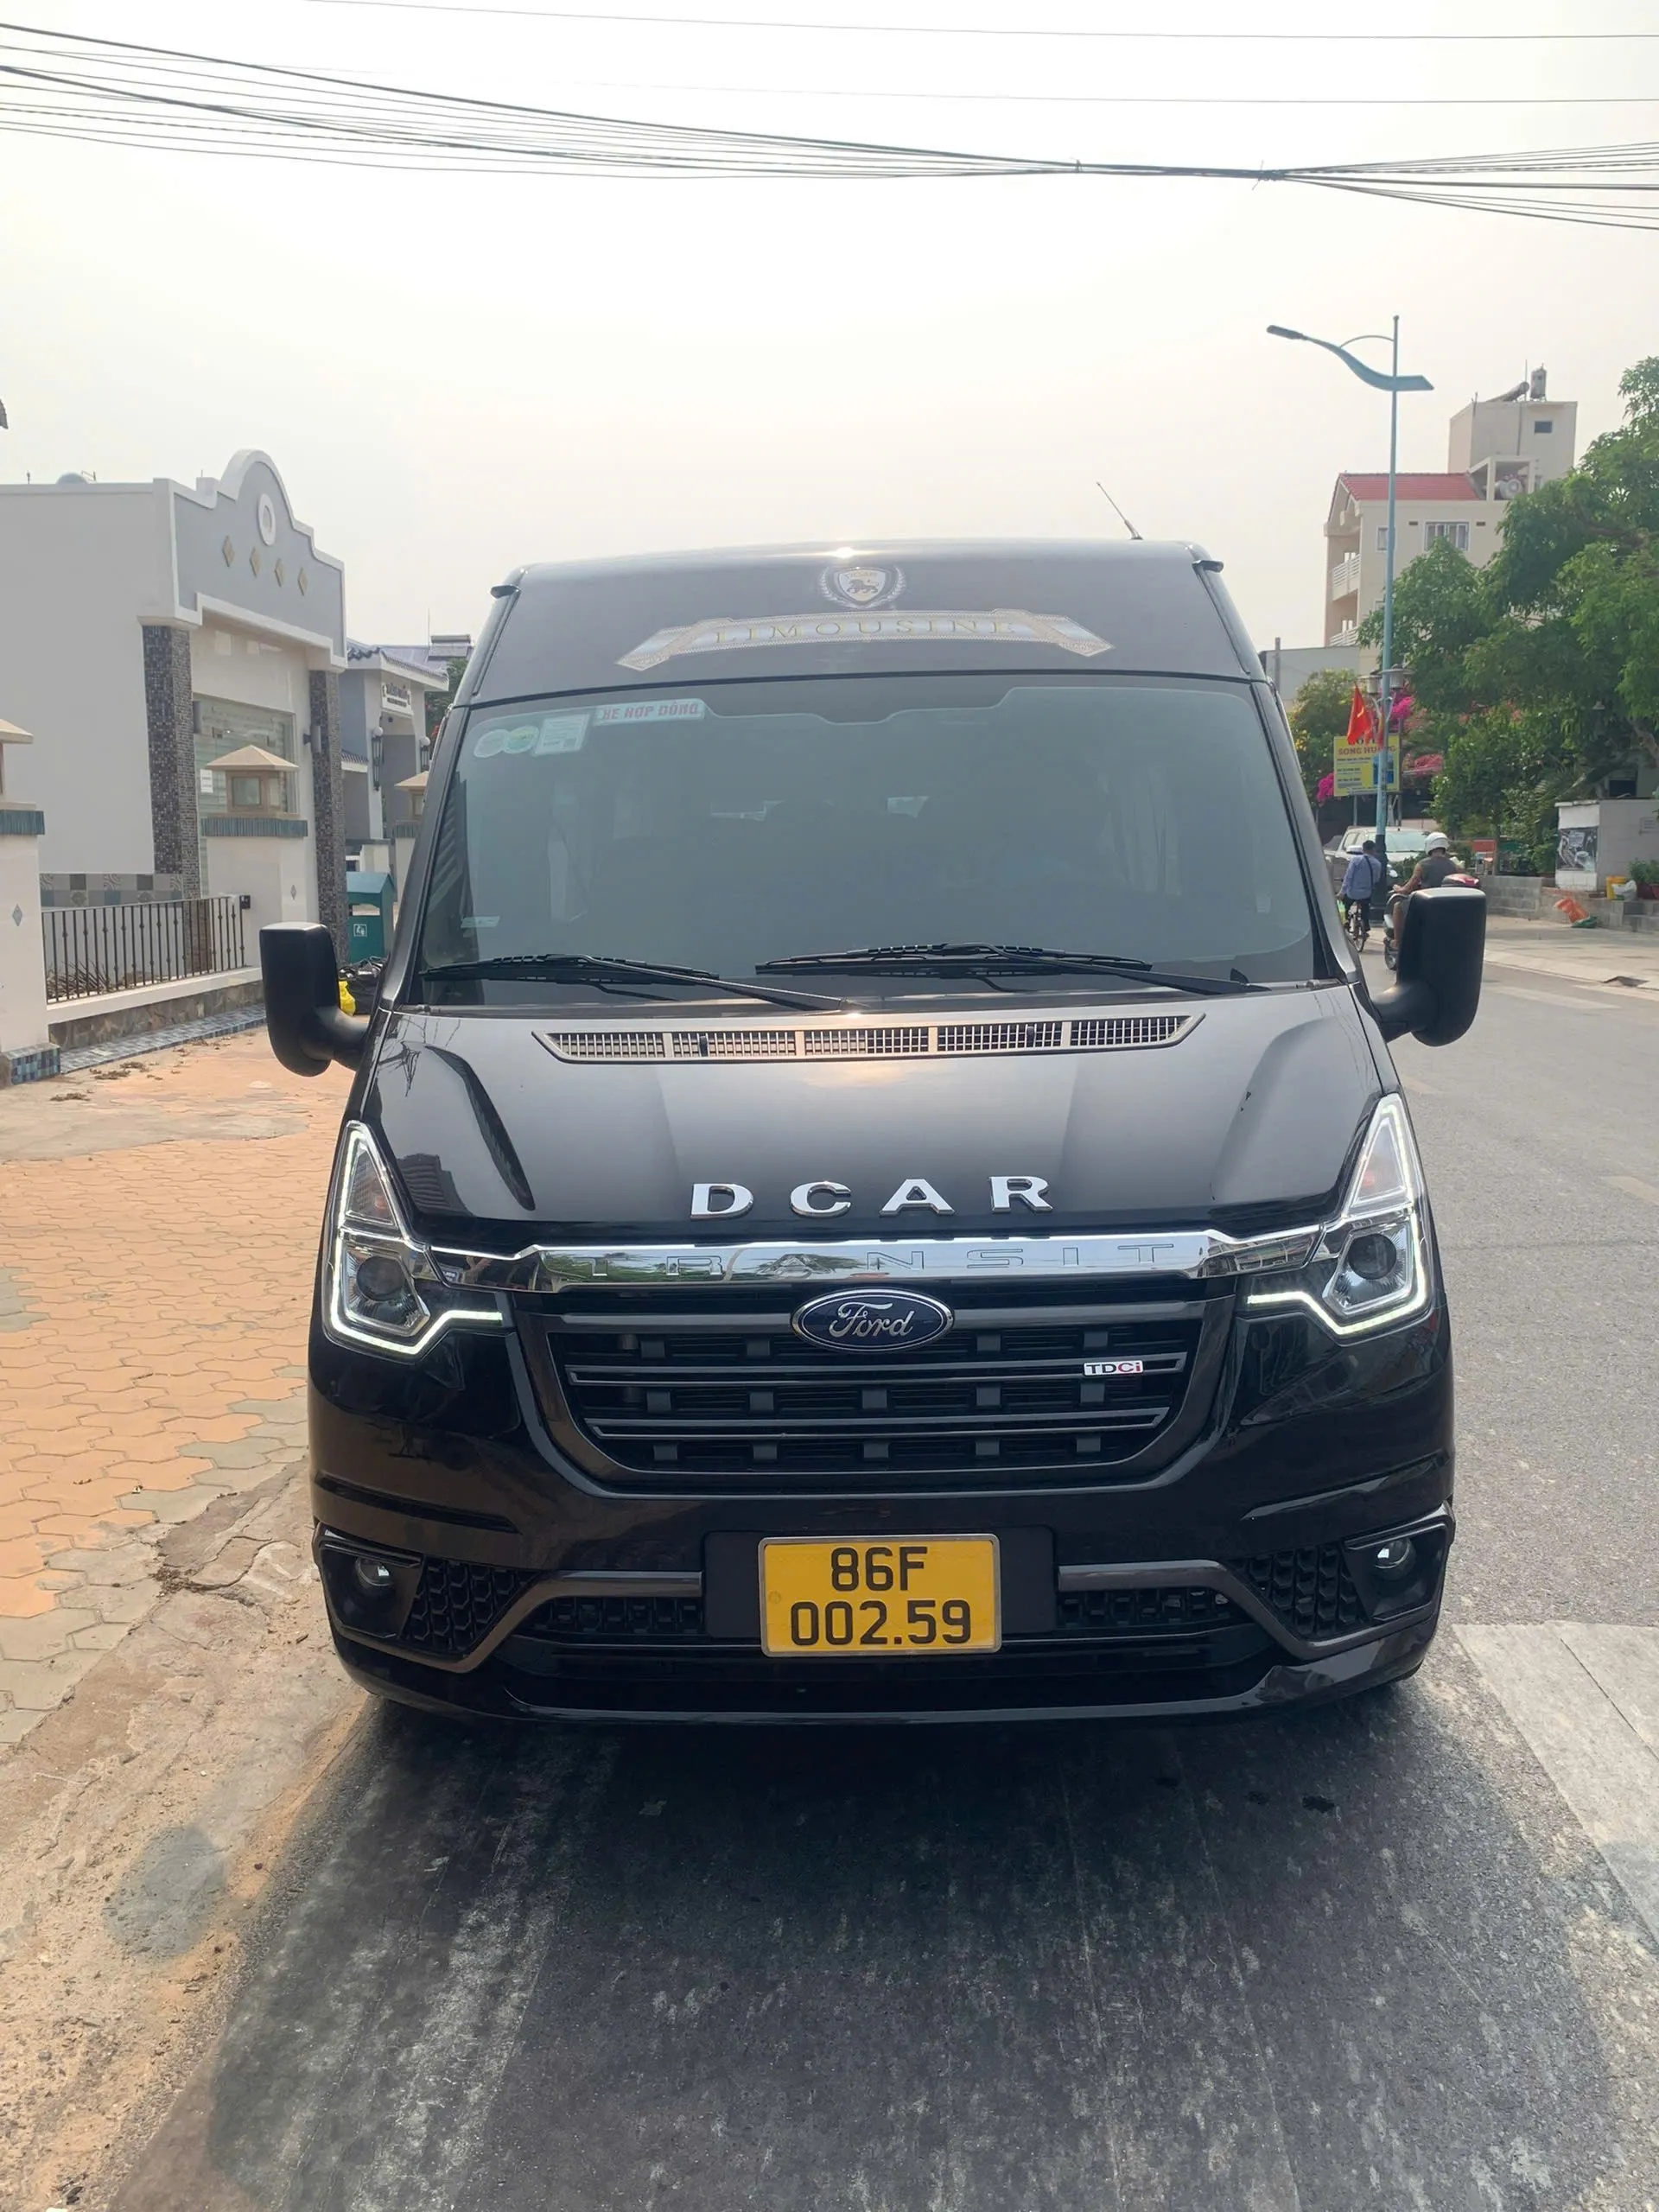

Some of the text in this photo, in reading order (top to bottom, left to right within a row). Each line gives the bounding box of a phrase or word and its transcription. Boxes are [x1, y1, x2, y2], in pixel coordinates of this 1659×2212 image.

[715, 619, 1015, 644] LIMOUSINE
[691, 1176, 1053, 1218] DCAR
[829, 1301, 915, 1338] Ford
[1085, 1362, 1141, 1374] TDCi
[831, 1545, 928, 1592] 86F
[791, 1599, 971, 1646] 002.59
